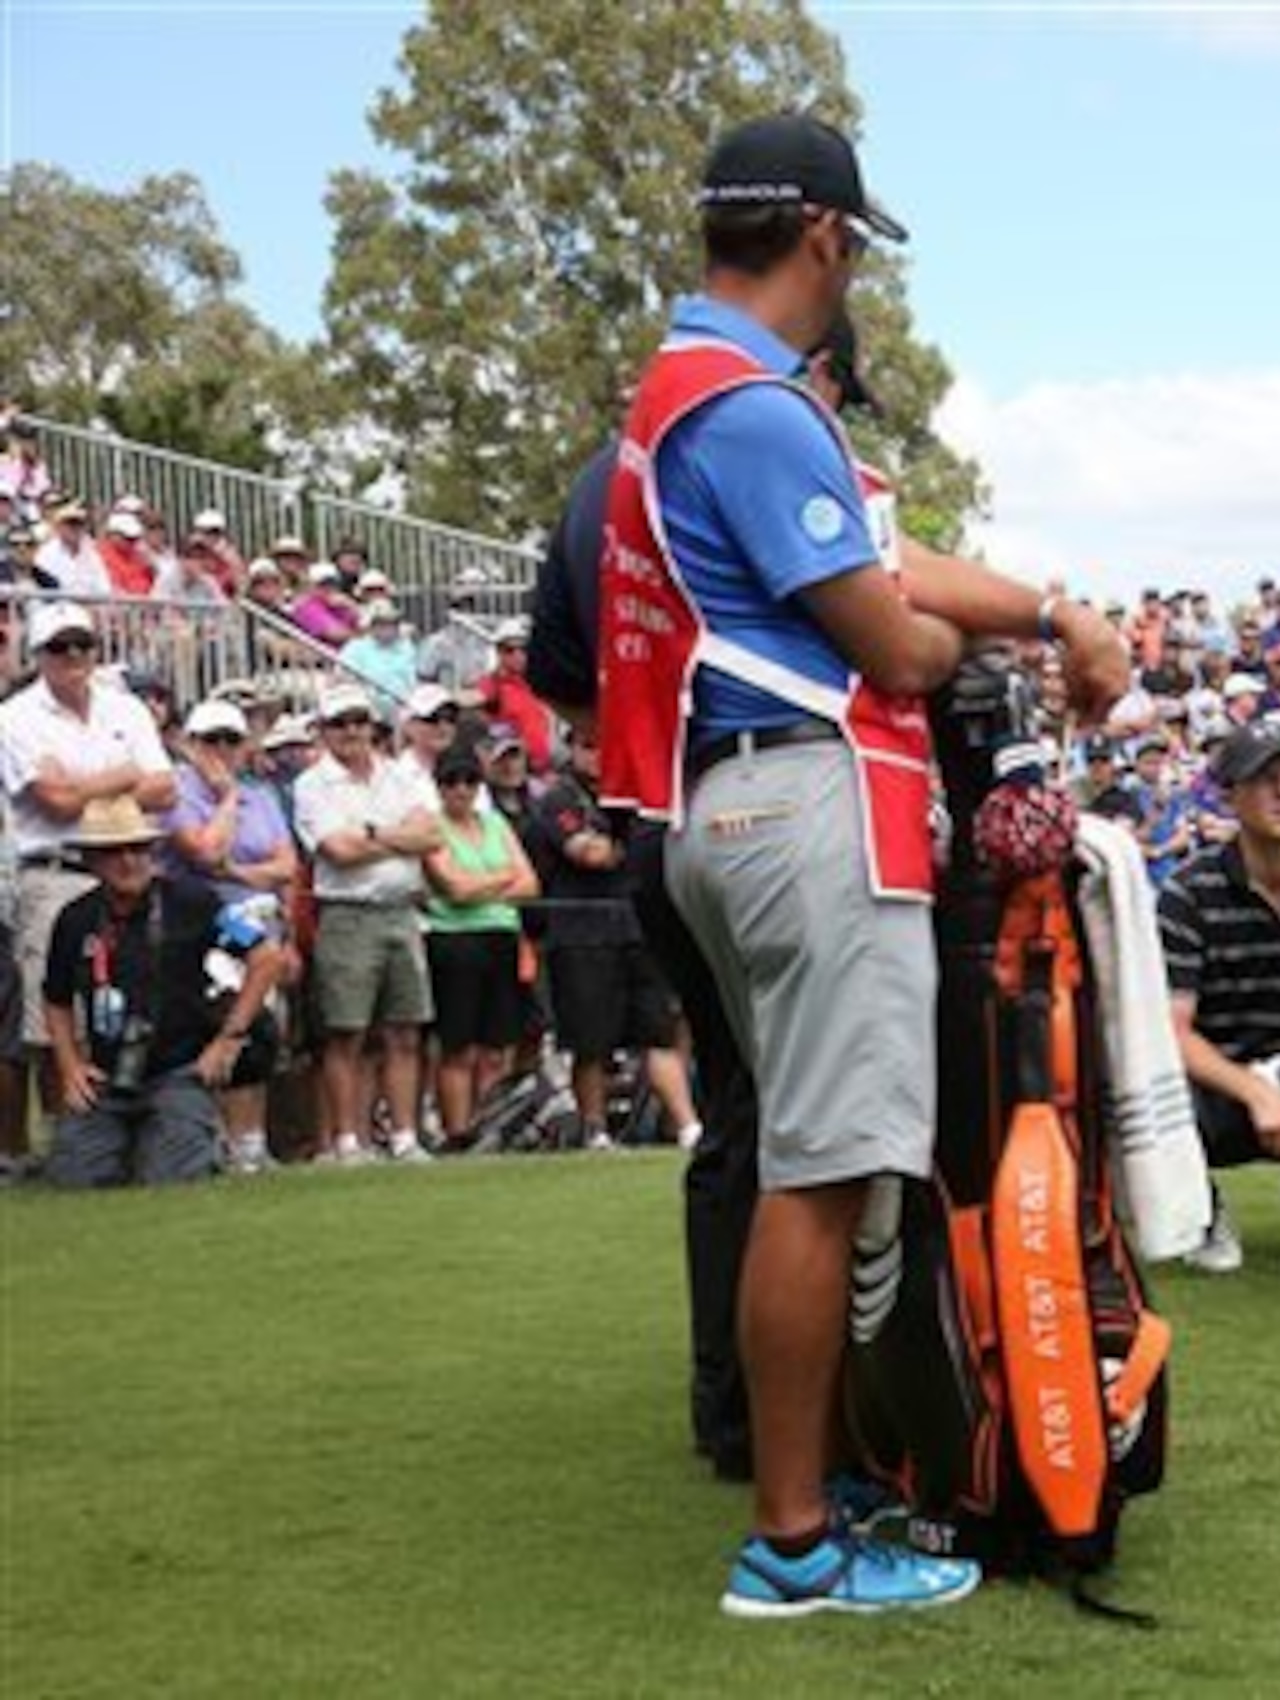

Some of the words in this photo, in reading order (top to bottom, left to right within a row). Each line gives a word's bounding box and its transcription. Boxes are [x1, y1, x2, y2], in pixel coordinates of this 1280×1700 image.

[1018, 1166, 1050, 1252] AT&T
[1025, 1277, 1062, 1358] AT&T
[1039, 1387, 1075, 1469] AT&T
